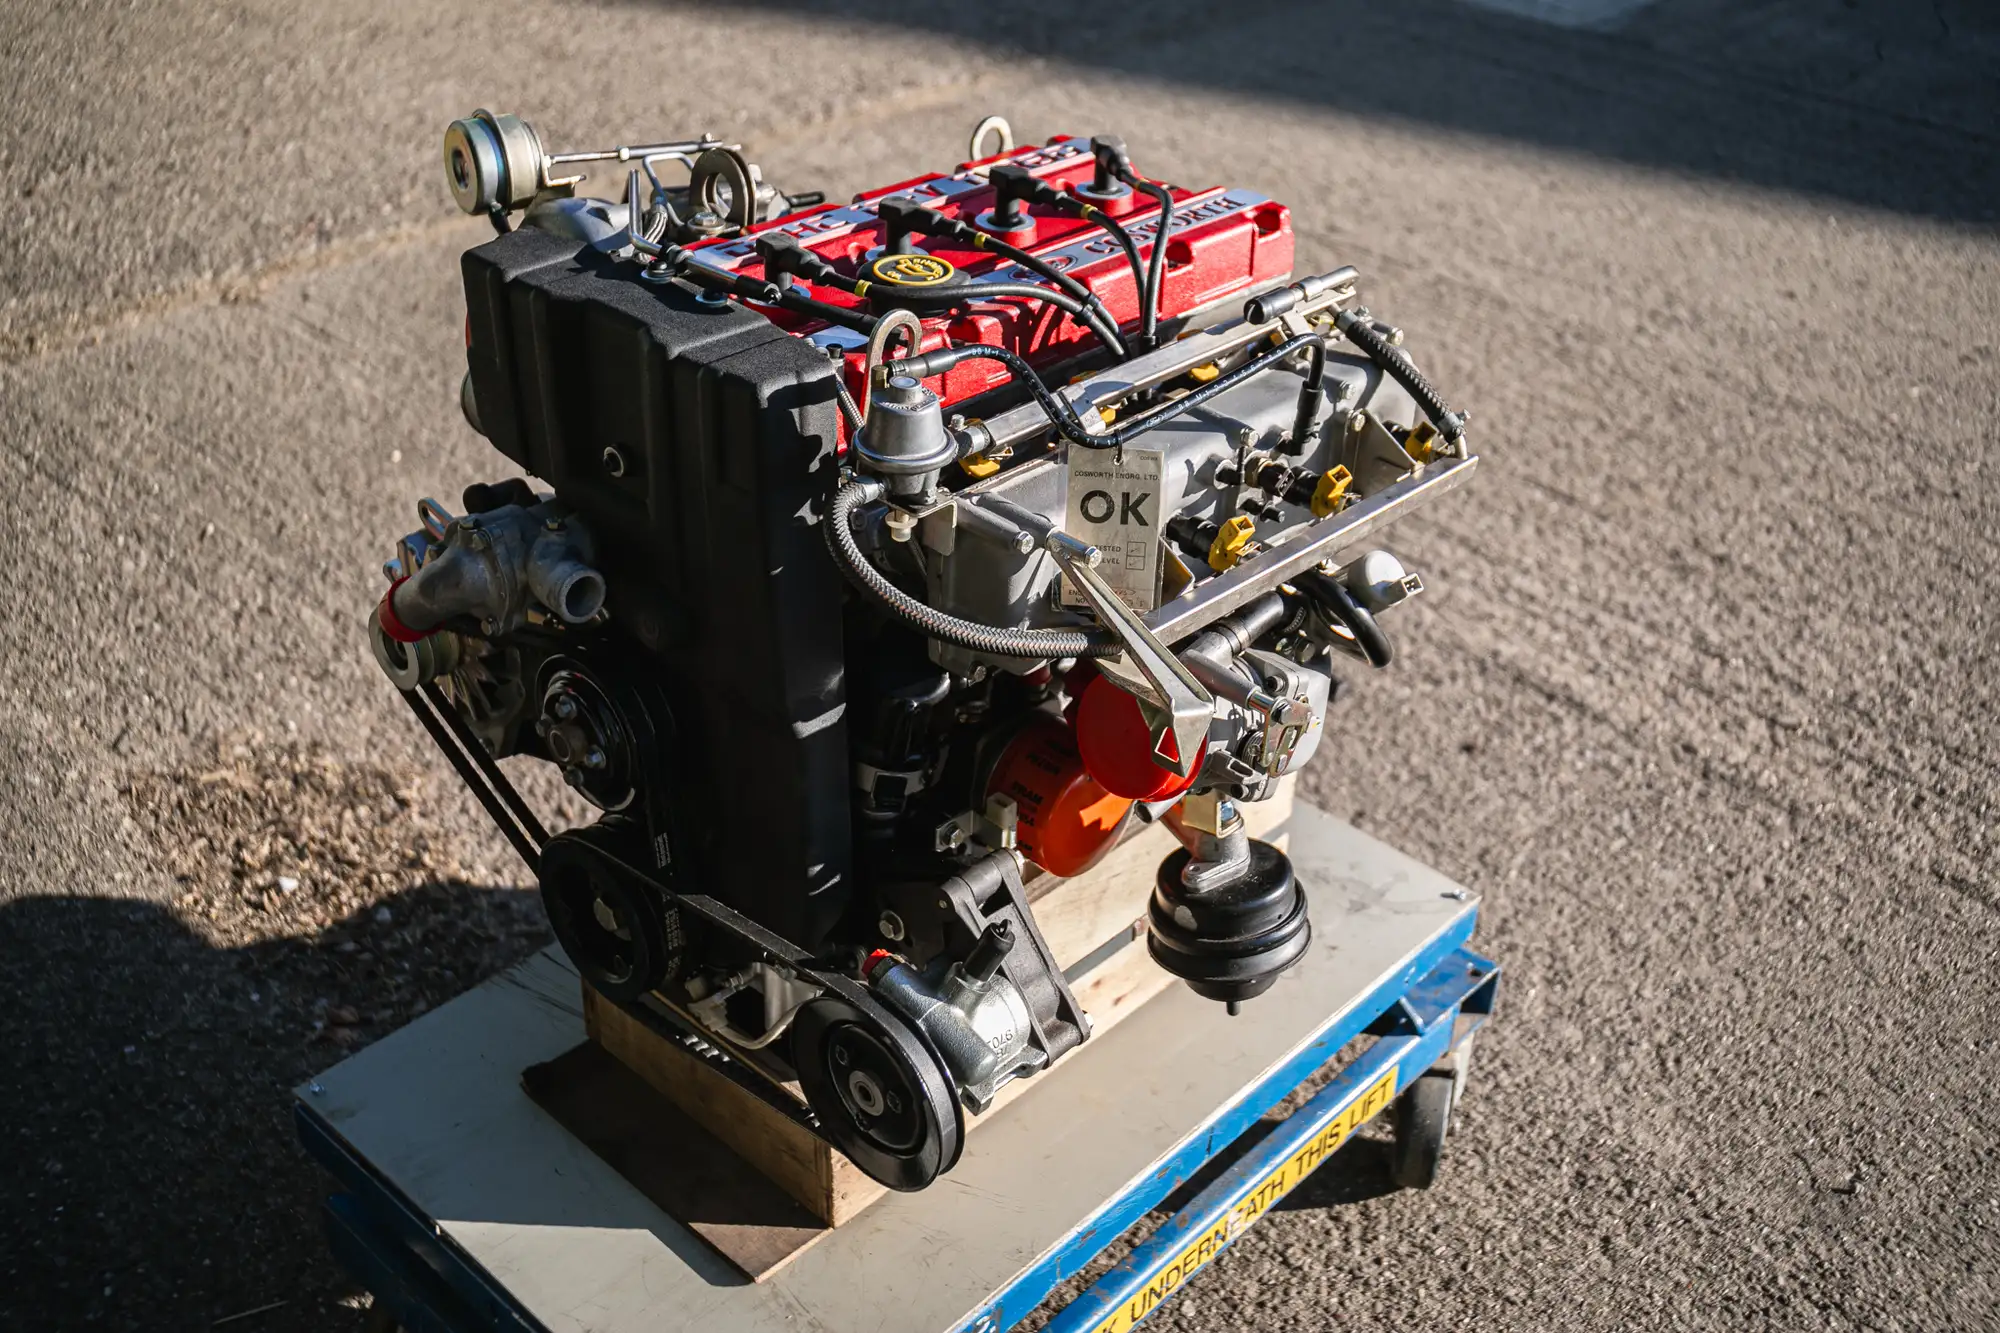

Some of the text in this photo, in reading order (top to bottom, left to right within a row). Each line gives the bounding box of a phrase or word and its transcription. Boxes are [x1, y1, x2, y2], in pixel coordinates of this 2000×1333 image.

[1074, 470, 1113, 479] COSWORTH
[1080, 489, 1151, 526] OK
[1130, 1077, 1394, 1322] UNDERNEATH THIS LIFT
